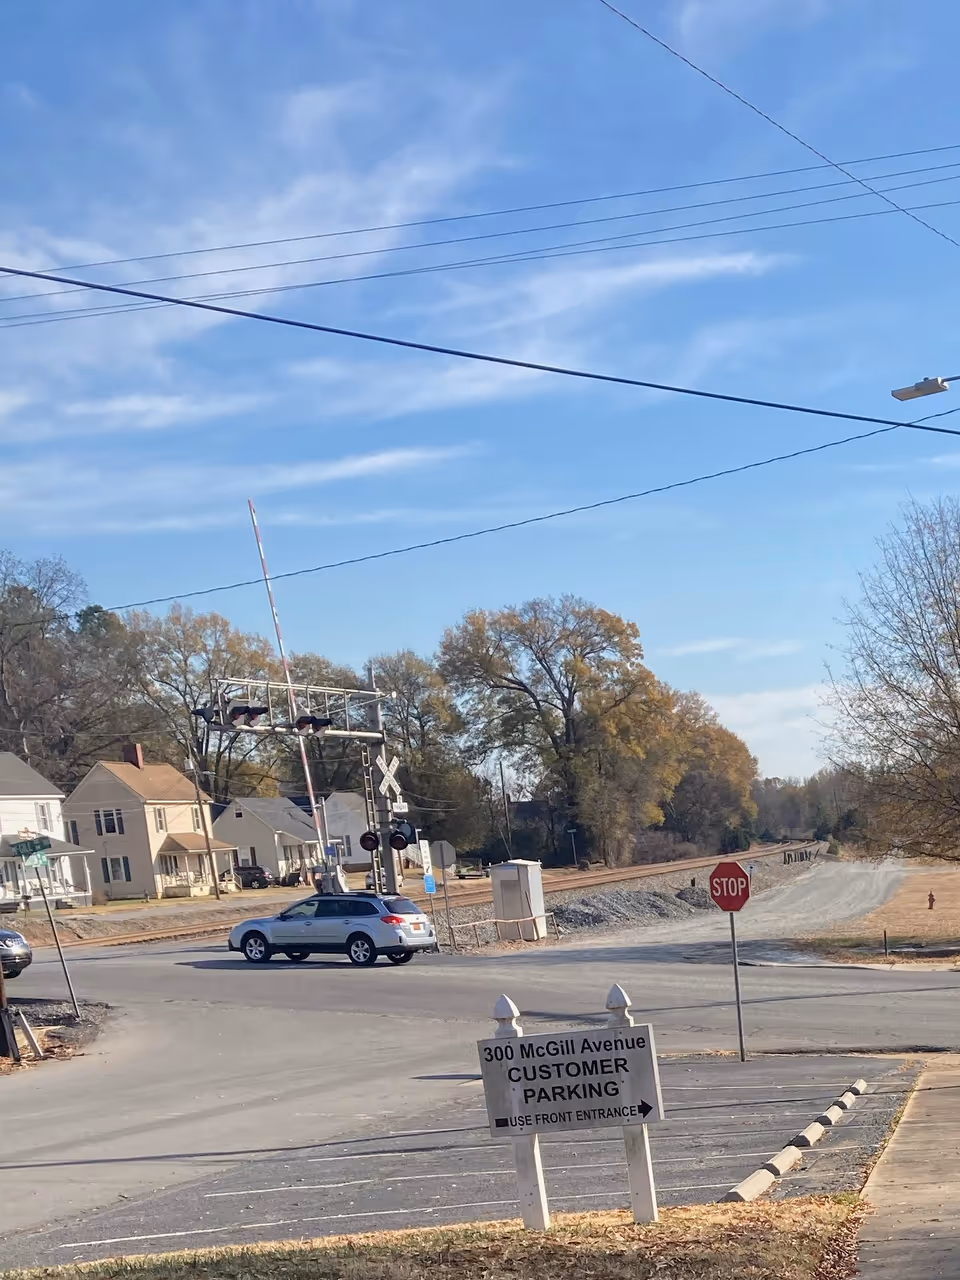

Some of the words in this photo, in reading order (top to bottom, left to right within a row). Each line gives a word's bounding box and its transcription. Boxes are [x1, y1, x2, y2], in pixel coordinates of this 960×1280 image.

[712, 878, 746, 896] STOP
[483, 1045, 514, 1062] 300
[520, 1040, 576, 1059] McGill
[580, 1036, 646, 1054] Avenue
[507, 1057, 630, 1083] CUSTOMER
[523, 1081, 620, 1104] PARKING
[509, 1114, 533, 1128] USE
[535, 1110, 573, 1126] FRONT
[576, 1105, 637, 1121] ENTRANCE
